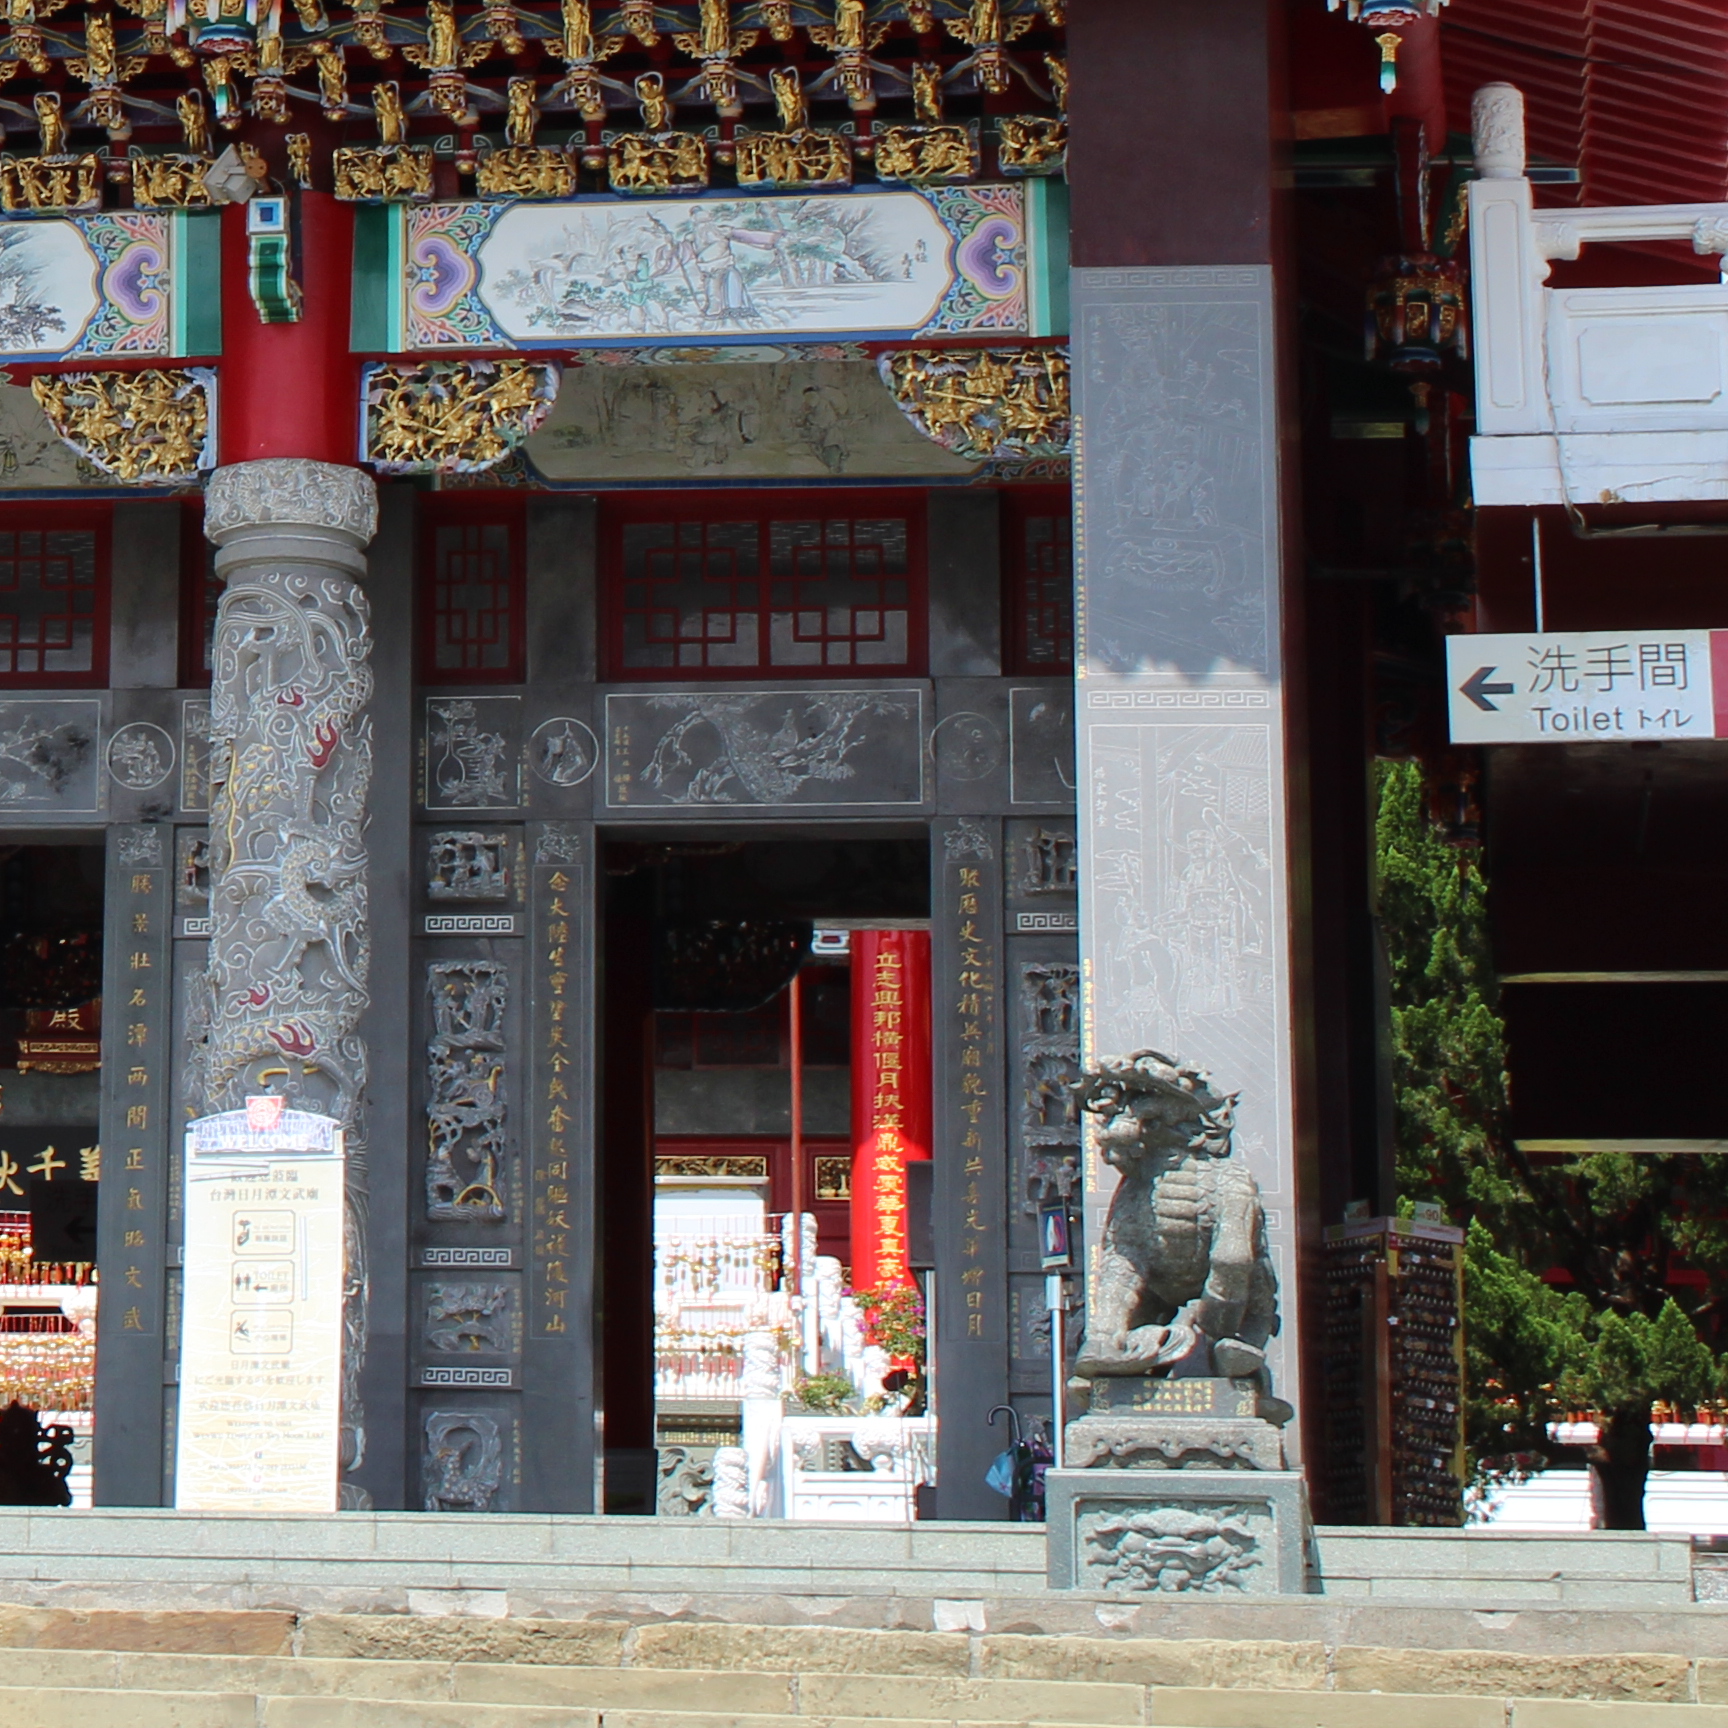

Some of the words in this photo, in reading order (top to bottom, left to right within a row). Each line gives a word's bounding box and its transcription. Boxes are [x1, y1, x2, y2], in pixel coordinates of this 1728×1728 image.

[1526, 643, 1688, 693] 洗手間
[1531, 705, 1624, 732] Toilet
[1638, 708, 1694, 729] トイレ
[48, 1007, 84, 1031] 殿
[219, 1133, 309, 1148] WELCOME
[209, 1188, 319, 1202] 台灣日月潭文武廟
[253, 1271, 290, 1281] TOILET
